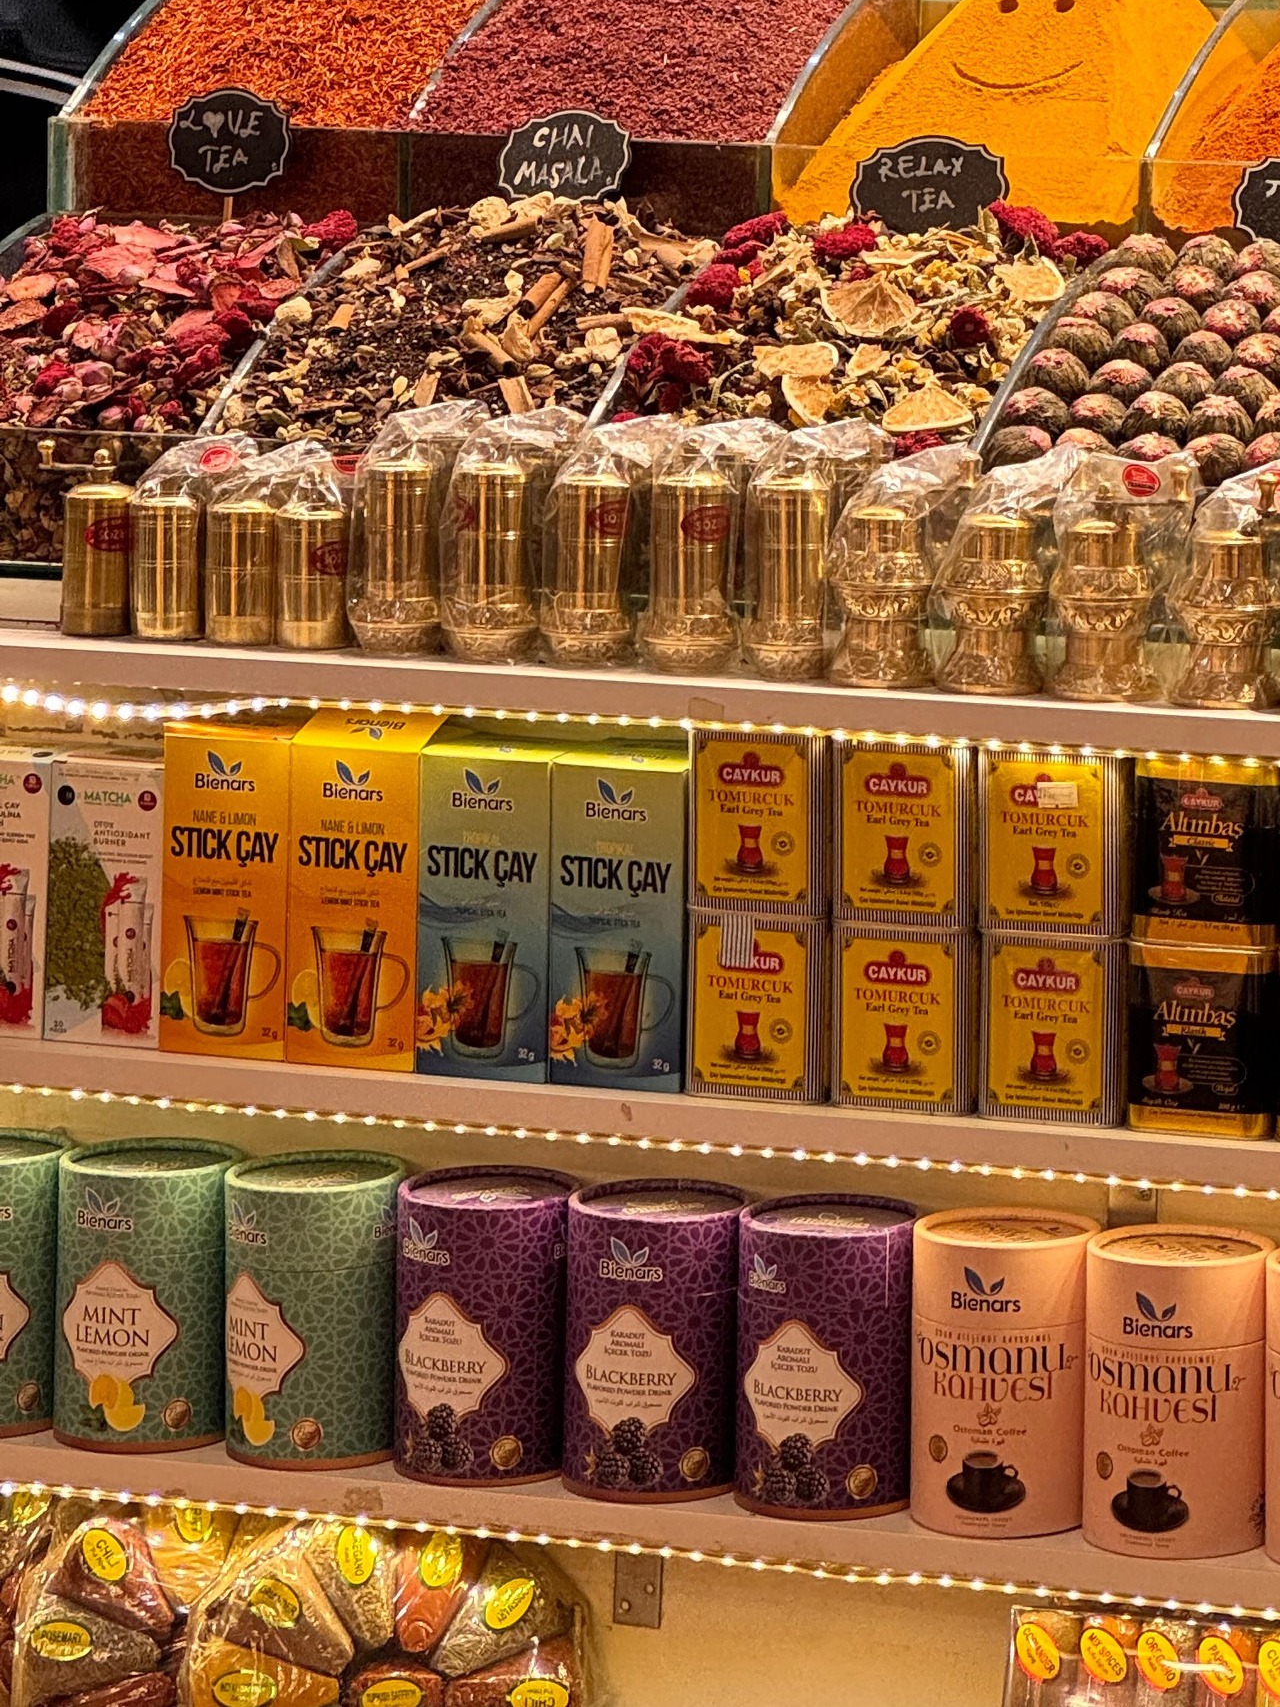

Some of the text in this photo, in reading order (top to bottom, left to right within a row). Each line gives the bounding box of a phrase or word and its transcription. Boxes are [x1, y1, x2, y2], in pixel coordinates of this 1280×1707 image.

[532, 123, 594, 150] CHAI
[197, 147, 249, 174] TEA
[512, 156, 603, 188] MASALA
[877, 151, 965, 183] RELAX
[900, 184, 955, 212] TEA
[194, 773, 255, 792] Bienars
[323, 782, 383, 802] Bienars
[452, 792, 513, 812] Bienars
[708, 789, 794, 807] TOMURCUK
[855, 800, 942, 819] TOMURCUK
[193, 810, 217, 824] NANE
[585, 802, 647, 822] Bienars
[741, 805, 762, 818] Grey
[1001, 811, 1089, 829] TOMURCUK
[321, 819, 344, 833] NANE
[93, 837, 126, 847] BURNER
[171, 825, 279, 867] STICK ÇAY
[298, 835, 408, 877] STICK ÇAY
[428, 845, 537, 887] STICK ÇAY
[560, 855, 623, 891] STICK
[628, 860, 672, 897] ÇAY
[707, 975, 794, 994] TOMURCUK
[853, 987, 941, 1006] TOMURCUK
[1003, 995, 1091, 1014] TOMURCUK
[77, 1208, 133, 1231] Bienars
[600, 1259, 663, 1283] Bienars
[951, 1290, 1021, 1314] Bienars
[82, 1305, 142, 1324] MINT
[76, 1324, 150, 1347] LEMON
[1122, 1316, 1193, 1340] Bienars
[404, 1350, 486, 1376] BLACKBERRY
[585, 1362, 678, 1387] BLACKBERRY
[753, 1377, 844, 1402] BLACKBERRY
[352, 1524, 365, 1577] REGANO
[40, 1631, 84, 1644] ROSEMARY
[1089, 1632, 1124, 1677] MIX SPICES
